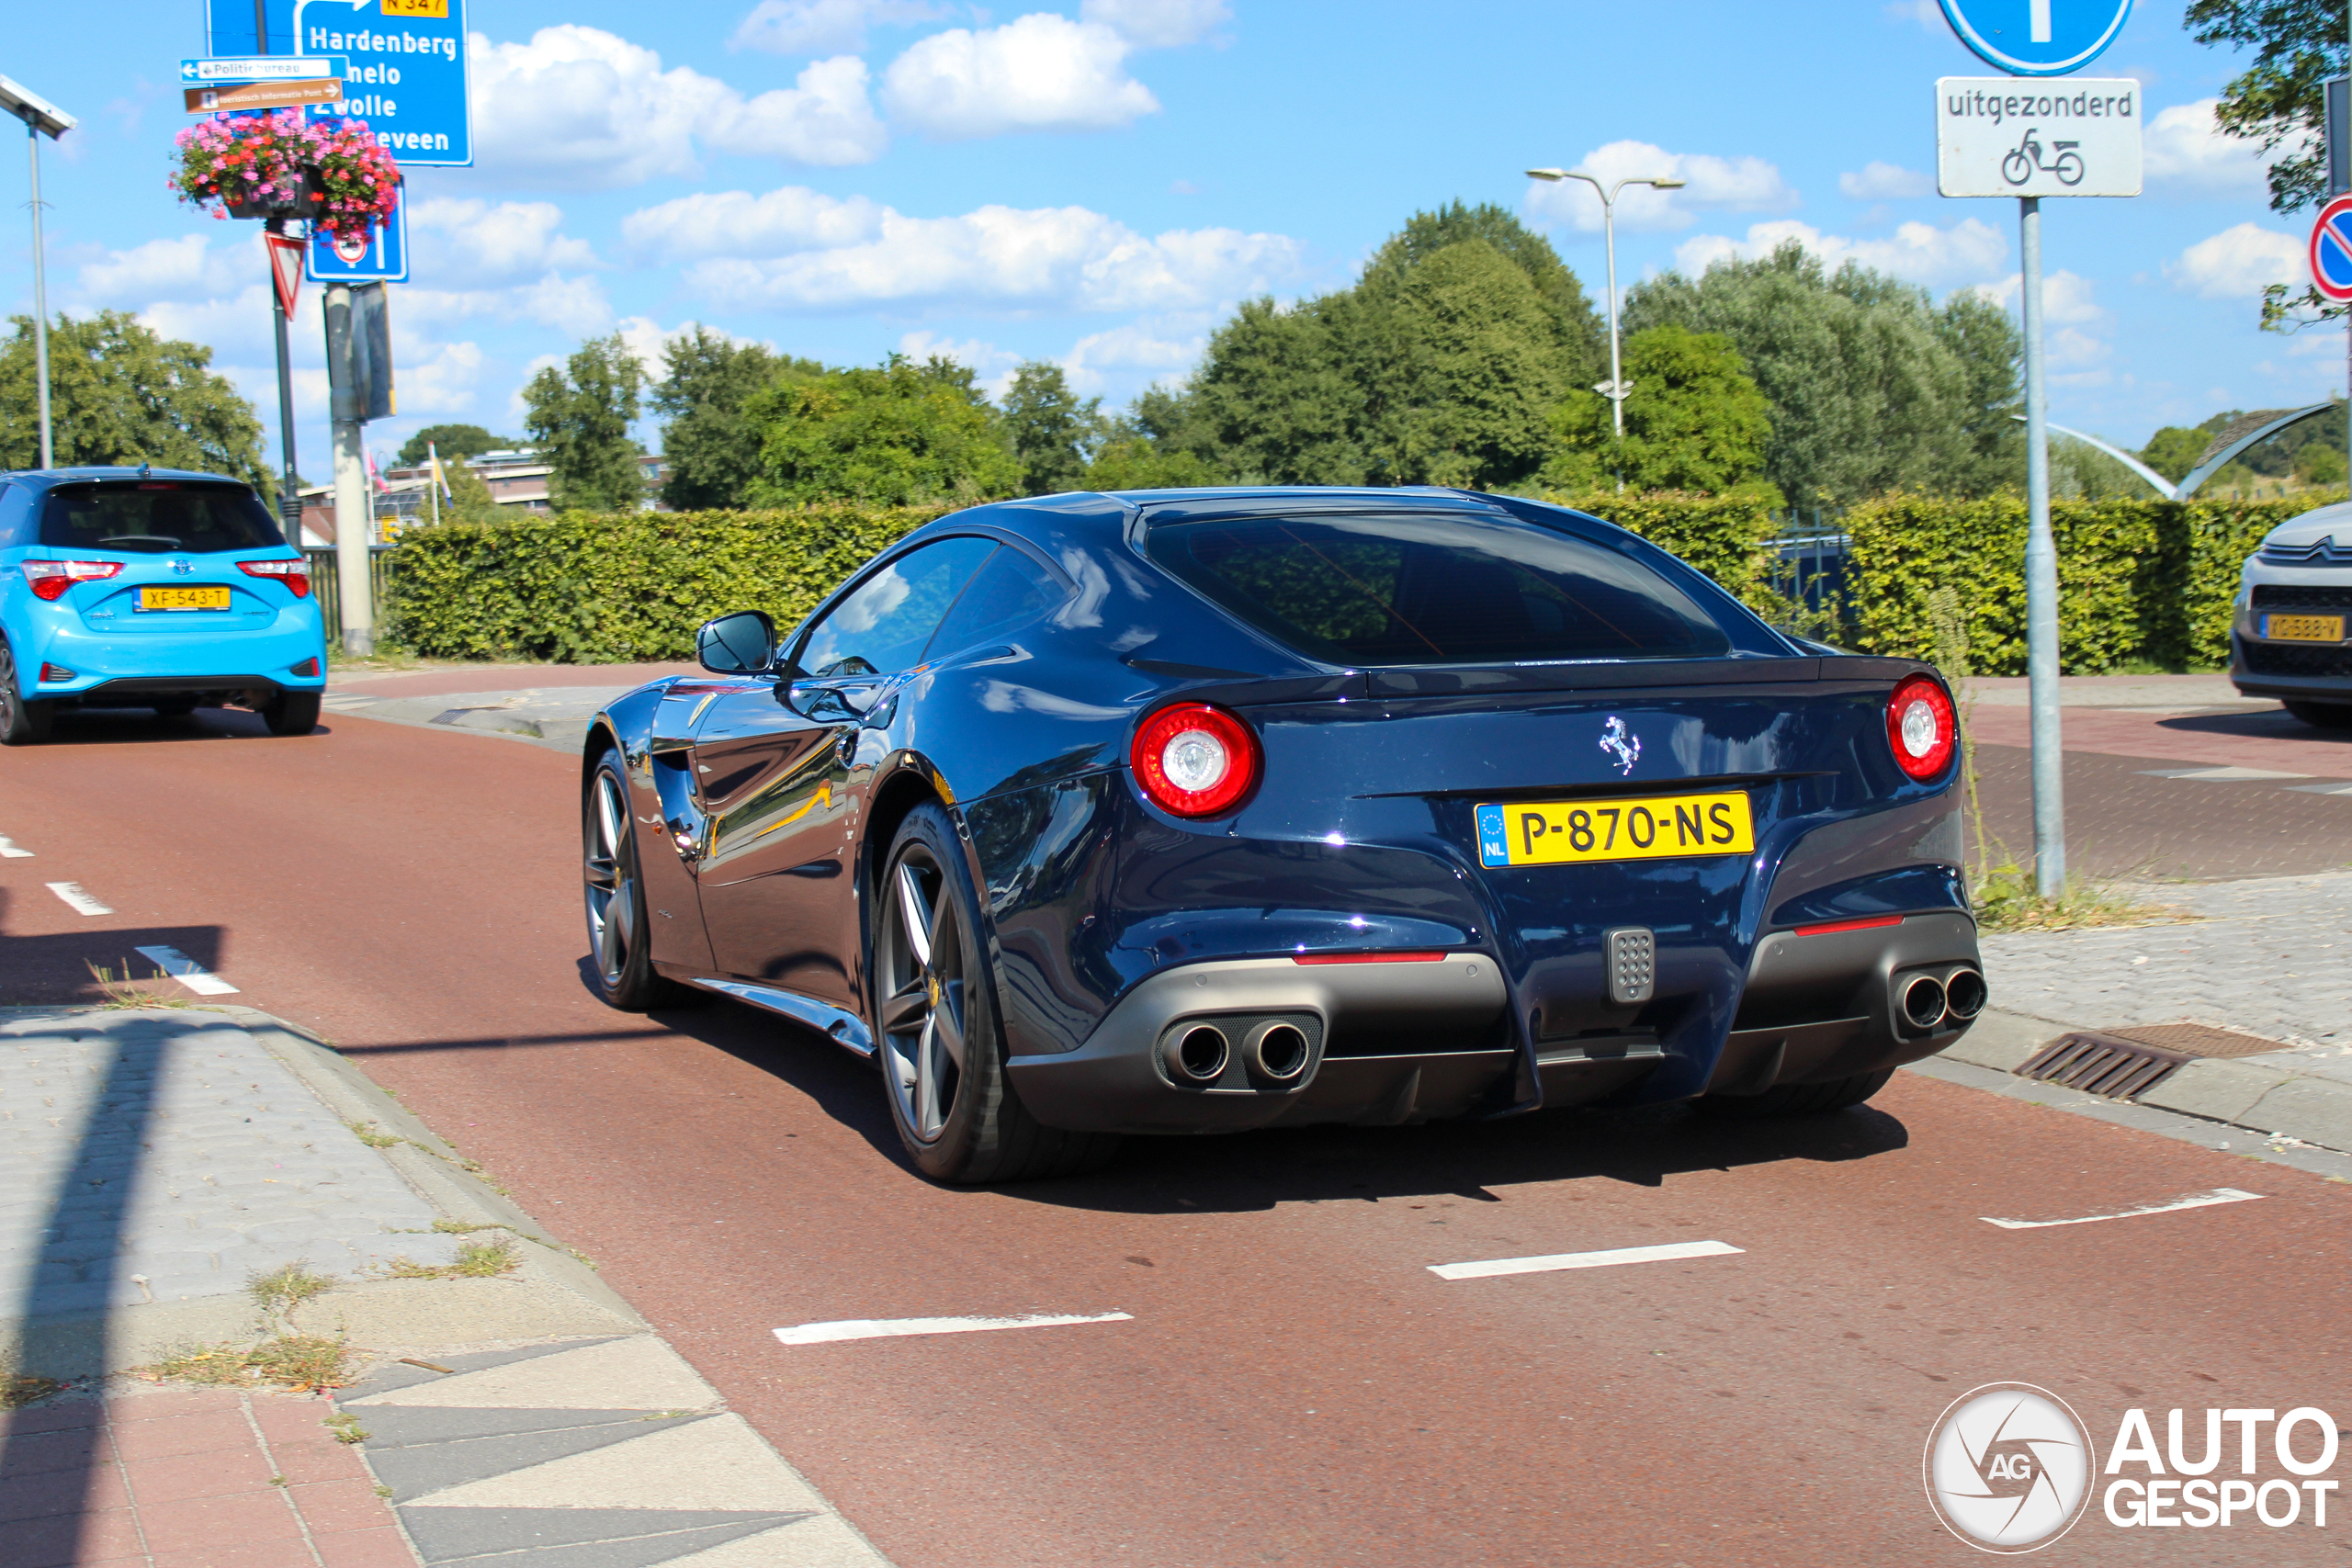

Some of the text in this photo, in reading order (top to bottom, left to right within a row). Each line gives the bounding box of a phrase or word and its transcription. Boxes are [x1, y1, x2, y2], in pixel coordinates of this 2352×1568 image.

[310, 27, 457, 62] Hardenberg
[1948, 90, 2132, 125] uitgezonderd
[150, 590, 223, 606] XF-543-T
[1521, 803, 1735, 855] P-870-NS
[1485, 842, 1505, 857] NL
